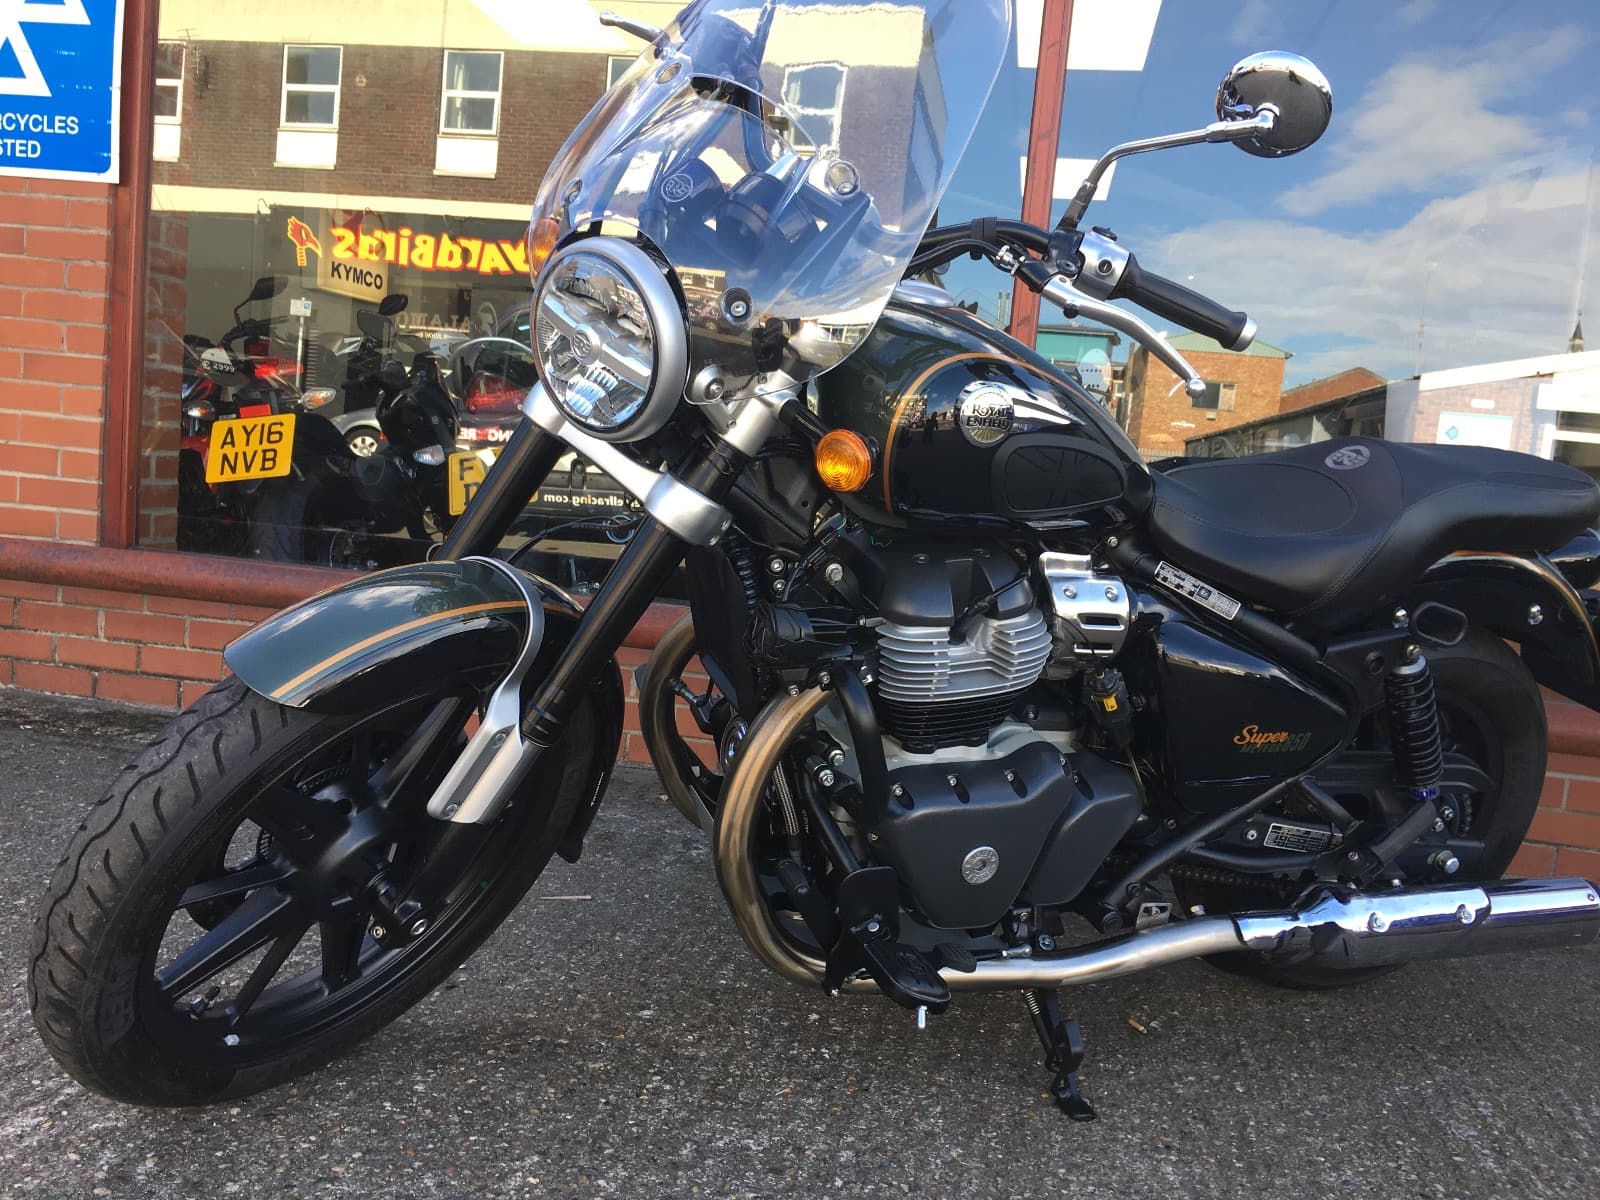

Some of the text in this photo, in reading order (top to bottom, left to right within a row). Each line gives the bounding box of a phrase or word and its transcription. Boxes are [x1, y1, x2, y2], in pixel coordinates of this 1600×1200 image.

[0, 112, 79, 135] CYCLES
[331, 261, 384, 290] KYMCO
[220, 421, 284, 449] AY16
[966, 415, 1010, 430] ENFIELD
[220, 448, 278, 476] NVB
[1233, 724, 1289, 748] Super
